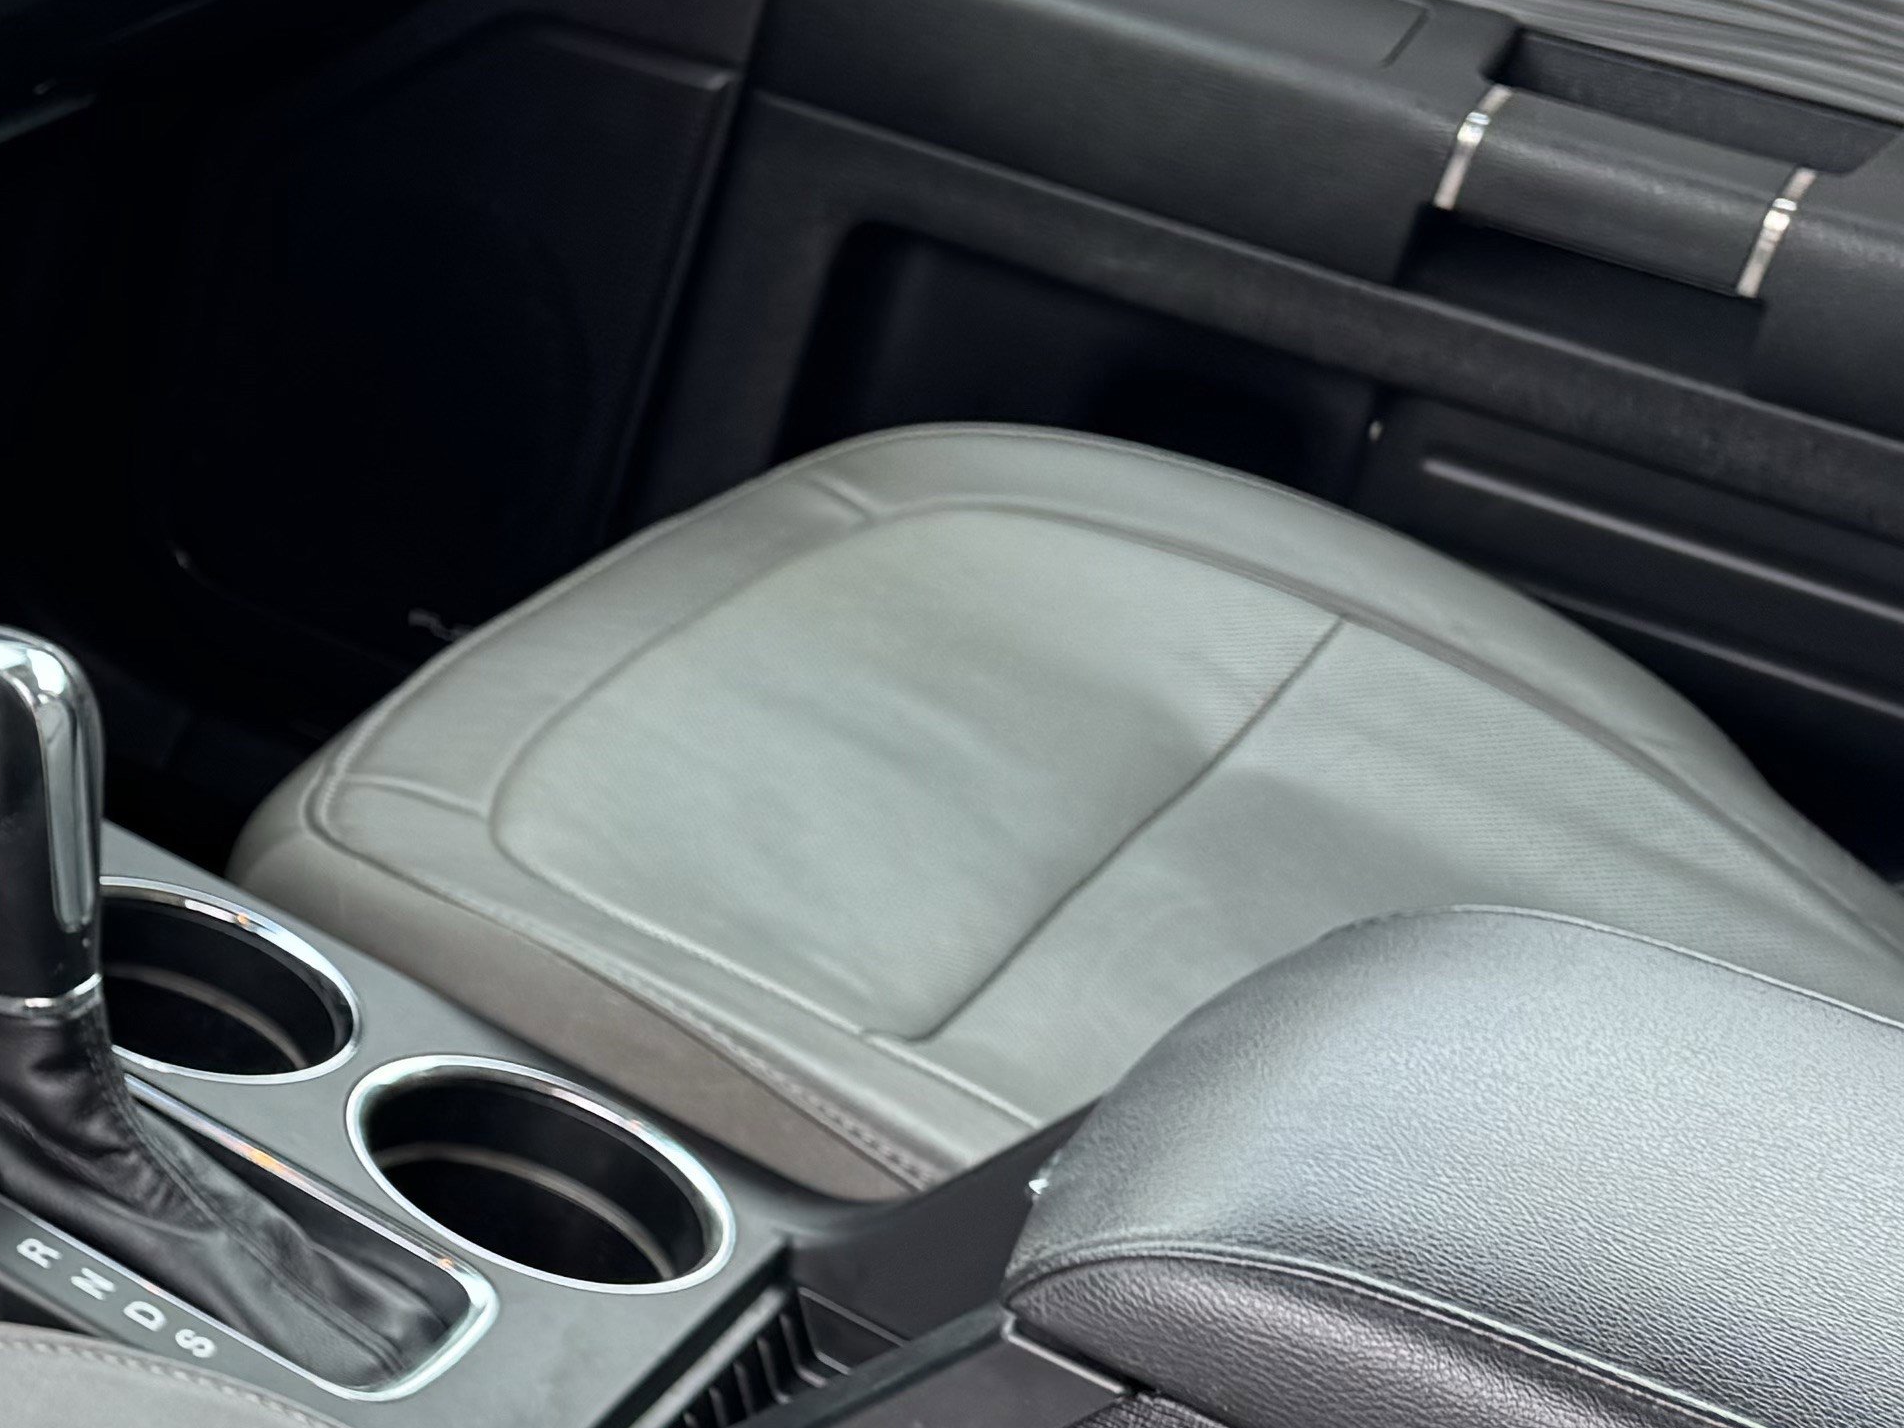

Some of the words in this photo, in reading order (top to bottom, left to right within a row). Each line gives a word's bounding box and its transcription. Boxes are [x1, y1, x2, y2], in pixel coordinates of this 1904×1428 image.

[16, 1238, 63, 1269] R
[70, 1267, 116, 1301] N
[123, 1301, 167, 1332] D
[175, 1329, 217, 1359] S
